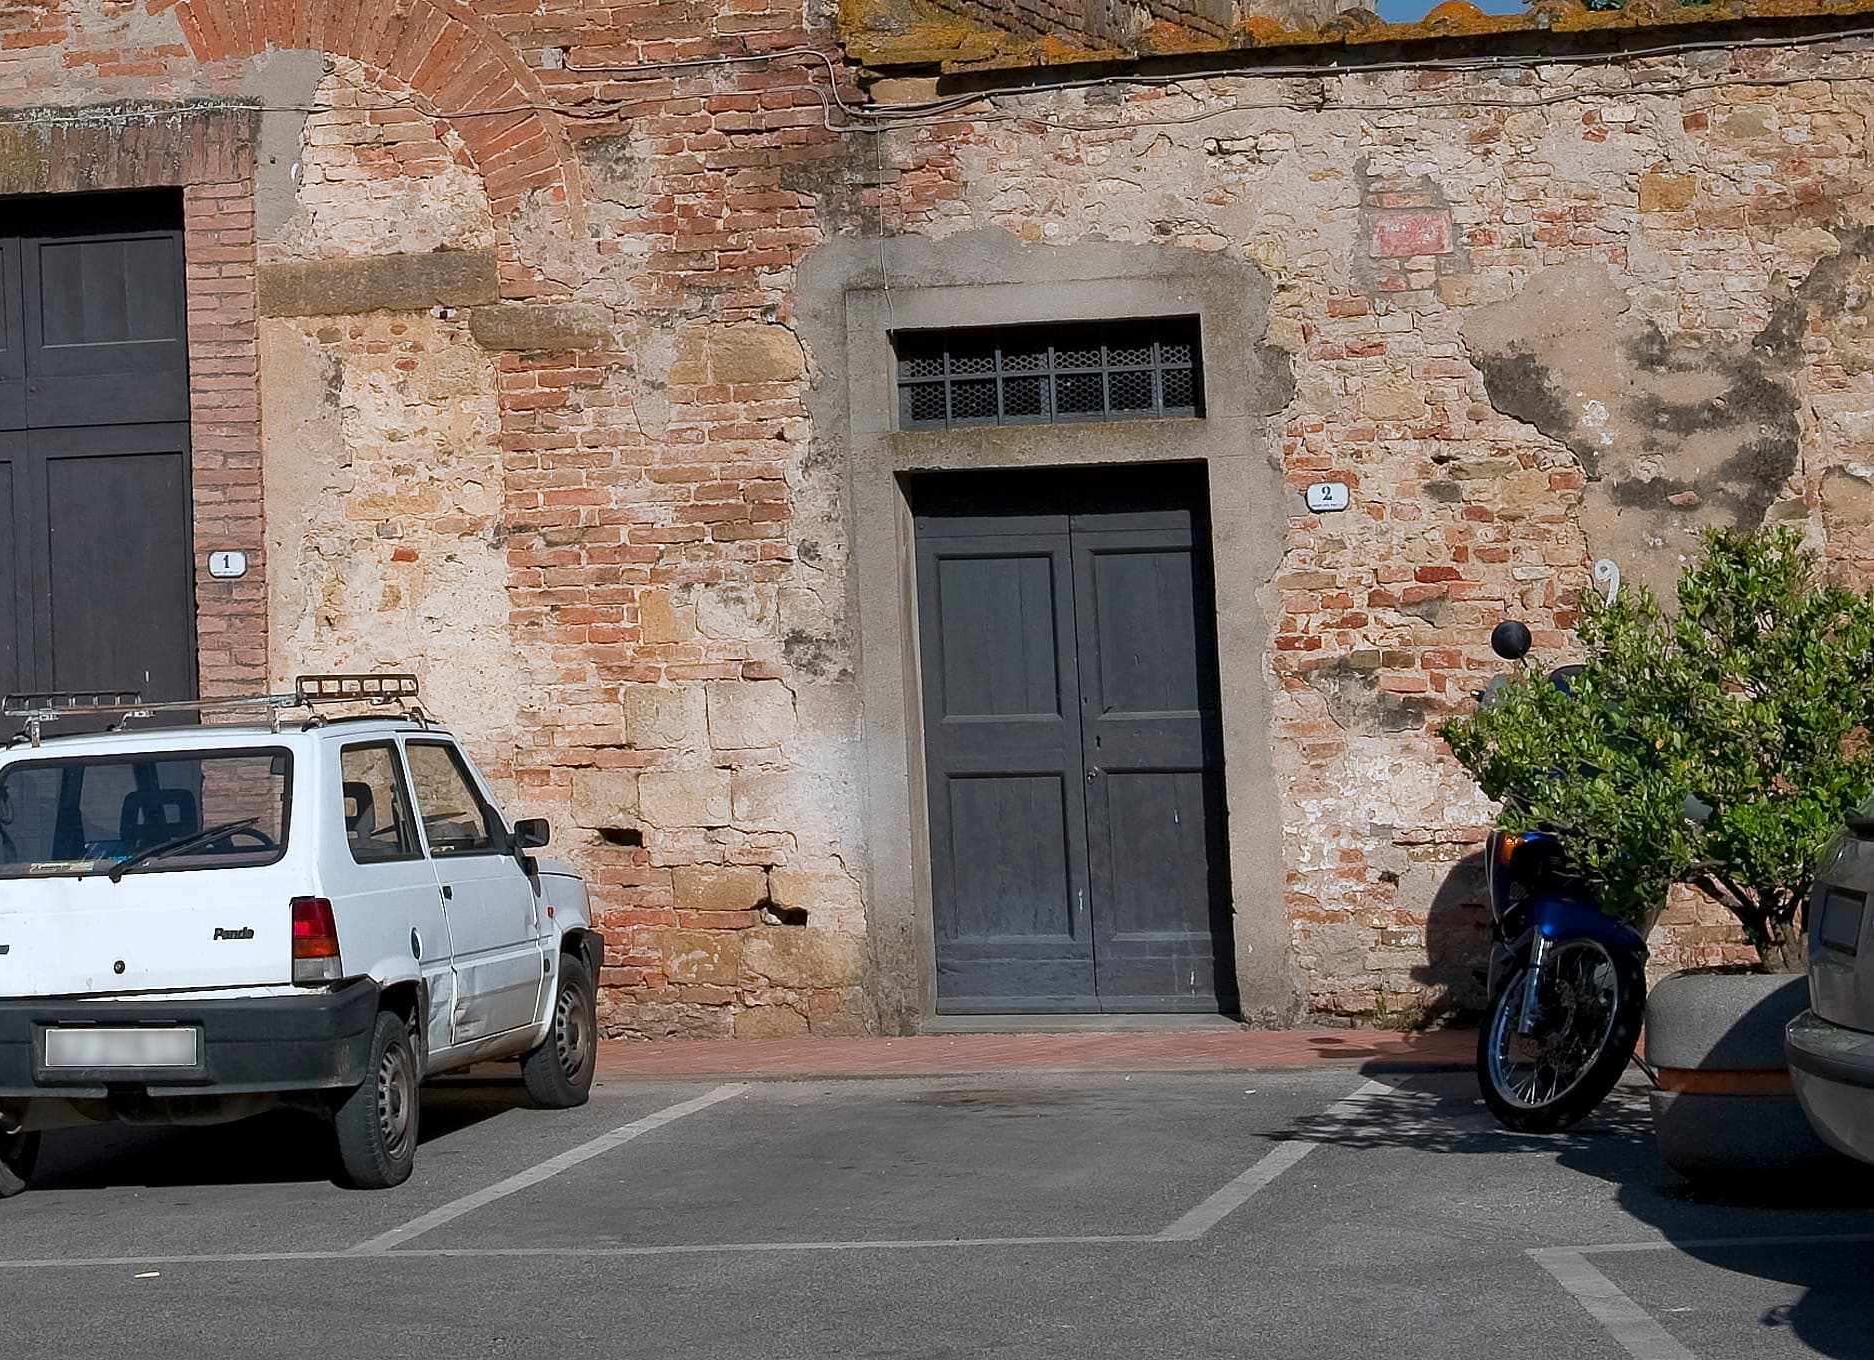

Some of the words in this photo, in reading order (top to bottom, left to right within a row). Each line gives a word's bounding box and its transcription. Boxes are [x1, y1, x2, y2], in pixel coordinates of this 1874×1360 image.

[1321, 485, 1333, 501] 2
[223, 554, 230, 569] 1
[213, 926, 255, 941] Panda
